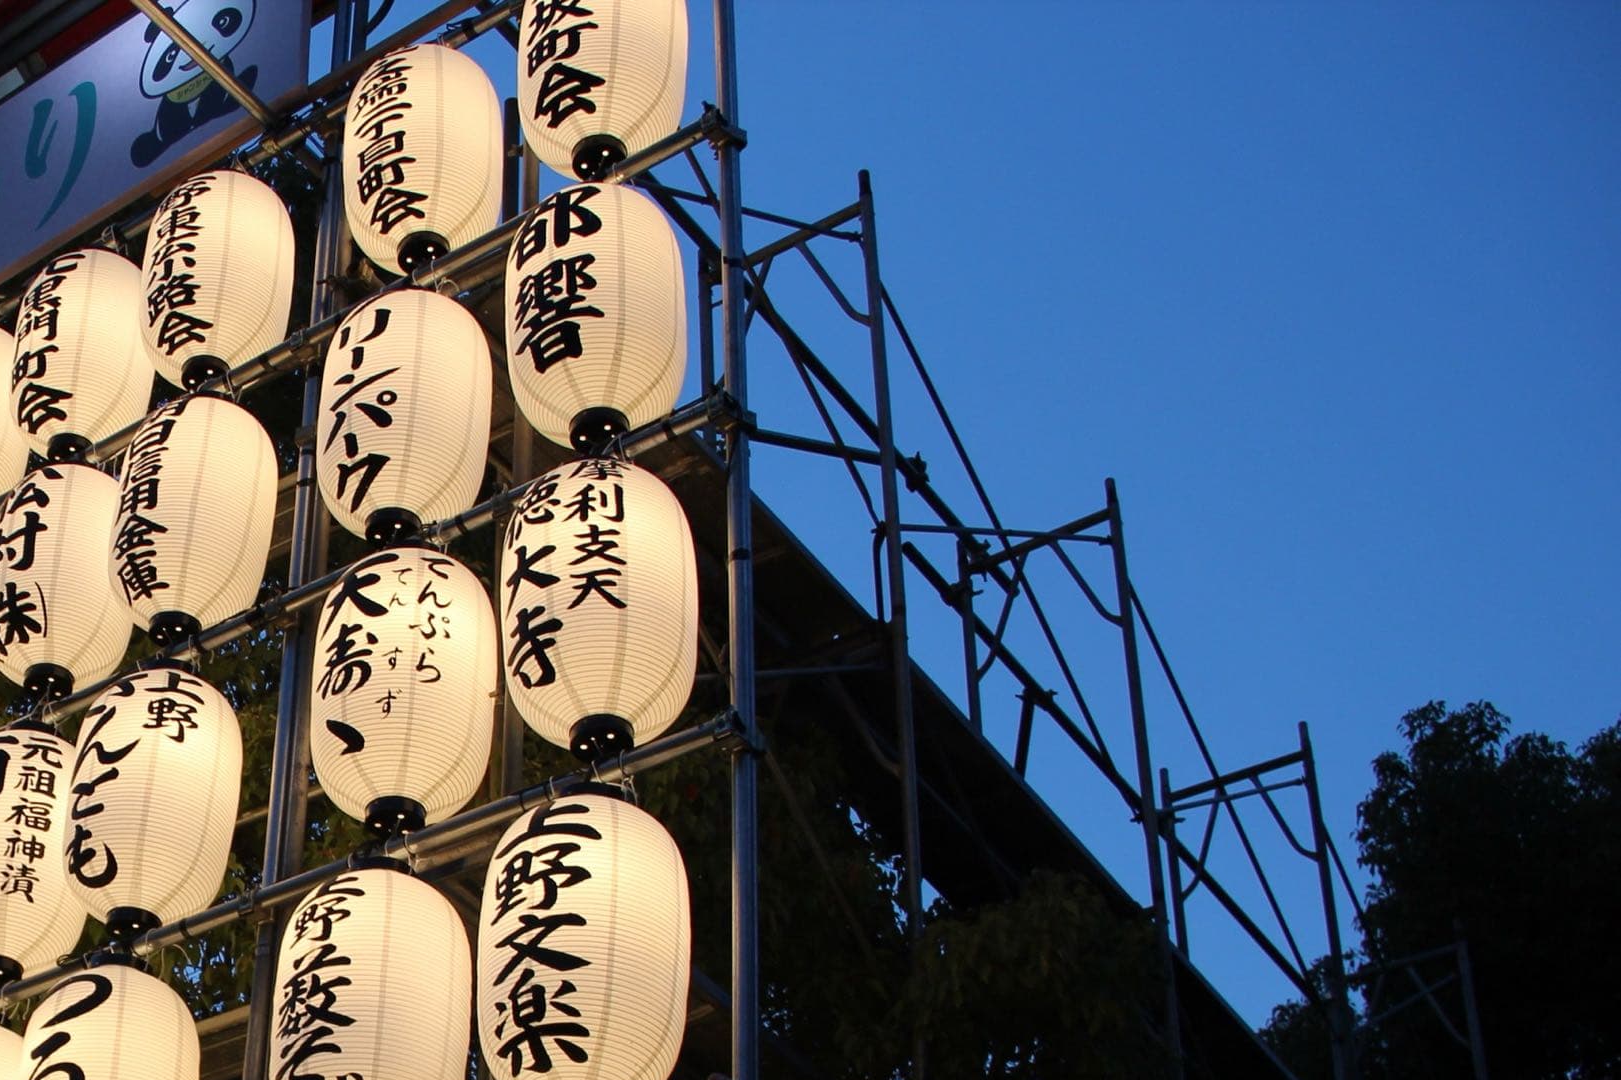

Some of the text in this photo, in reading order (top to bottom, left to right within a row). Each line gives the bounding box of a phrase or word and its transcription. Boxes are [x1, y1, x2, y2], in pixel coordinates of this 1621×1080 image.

[353, 46, 428, 234] 之端二丁目町会
[511, 185, 605, 373] 都響
[409, 556, 451, 684] てんぷら
[505, 476, 564, 690] 徳大寺
[563, 460, 627, 609] 摩利支天
[142, 672, 205, 743] 上野
[1, 736, 63, 904] 元祖福神漬
[491, 803, 602, 1078] 上野文楽
